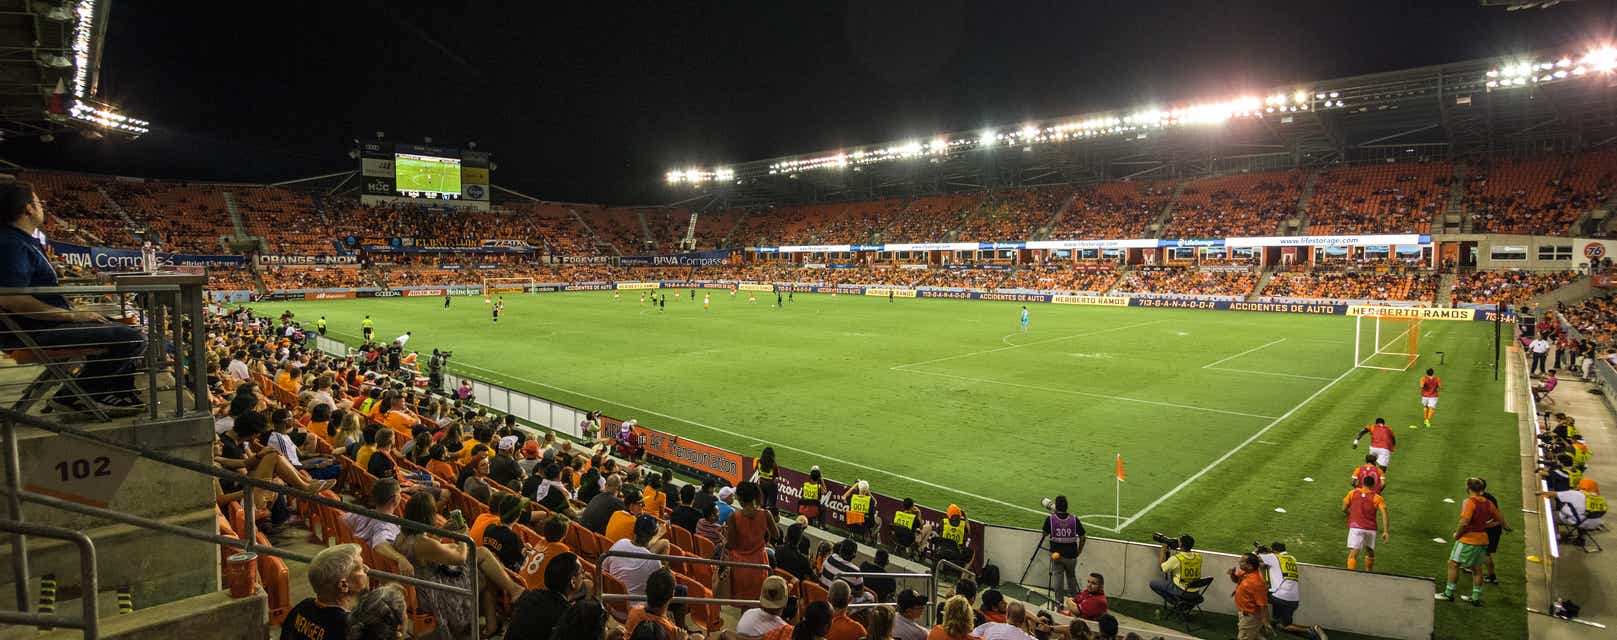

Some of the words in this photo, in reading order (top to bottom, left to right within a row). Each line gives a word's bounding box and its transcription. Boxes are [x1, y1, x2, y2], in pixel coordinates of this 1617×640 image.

[1280, 238, 1358, 246] www.lifestorage.com
[1586, 246, 1601, 255] 76
[96, 252, 174, 268] Compss
[261, 256, 314, 264] ORANGE
[654, 256, 678, 264] BBVA
[680, 256, 721, 266] Compass
[446, 288, 480, 296] Heineken
[1056, 296, 1096, 304] HERIBERTO
[1100, 297, 1125, 305] RAMOS
[1138, 298, 1216, 309] 713-G-A-N-A-D-O-R
[1229, 302, 1288, 312] ACCIDENTES
[1290, 304, 1303, 312] DE
[1306, 305, 1334, 314] AUTO
[1424, 310, 1468, 318] RAMOS
[669, 436, 737, 475] Transportation
[54, 456, 112, 482] 102
[1056, 528, 1072, 536] 309
